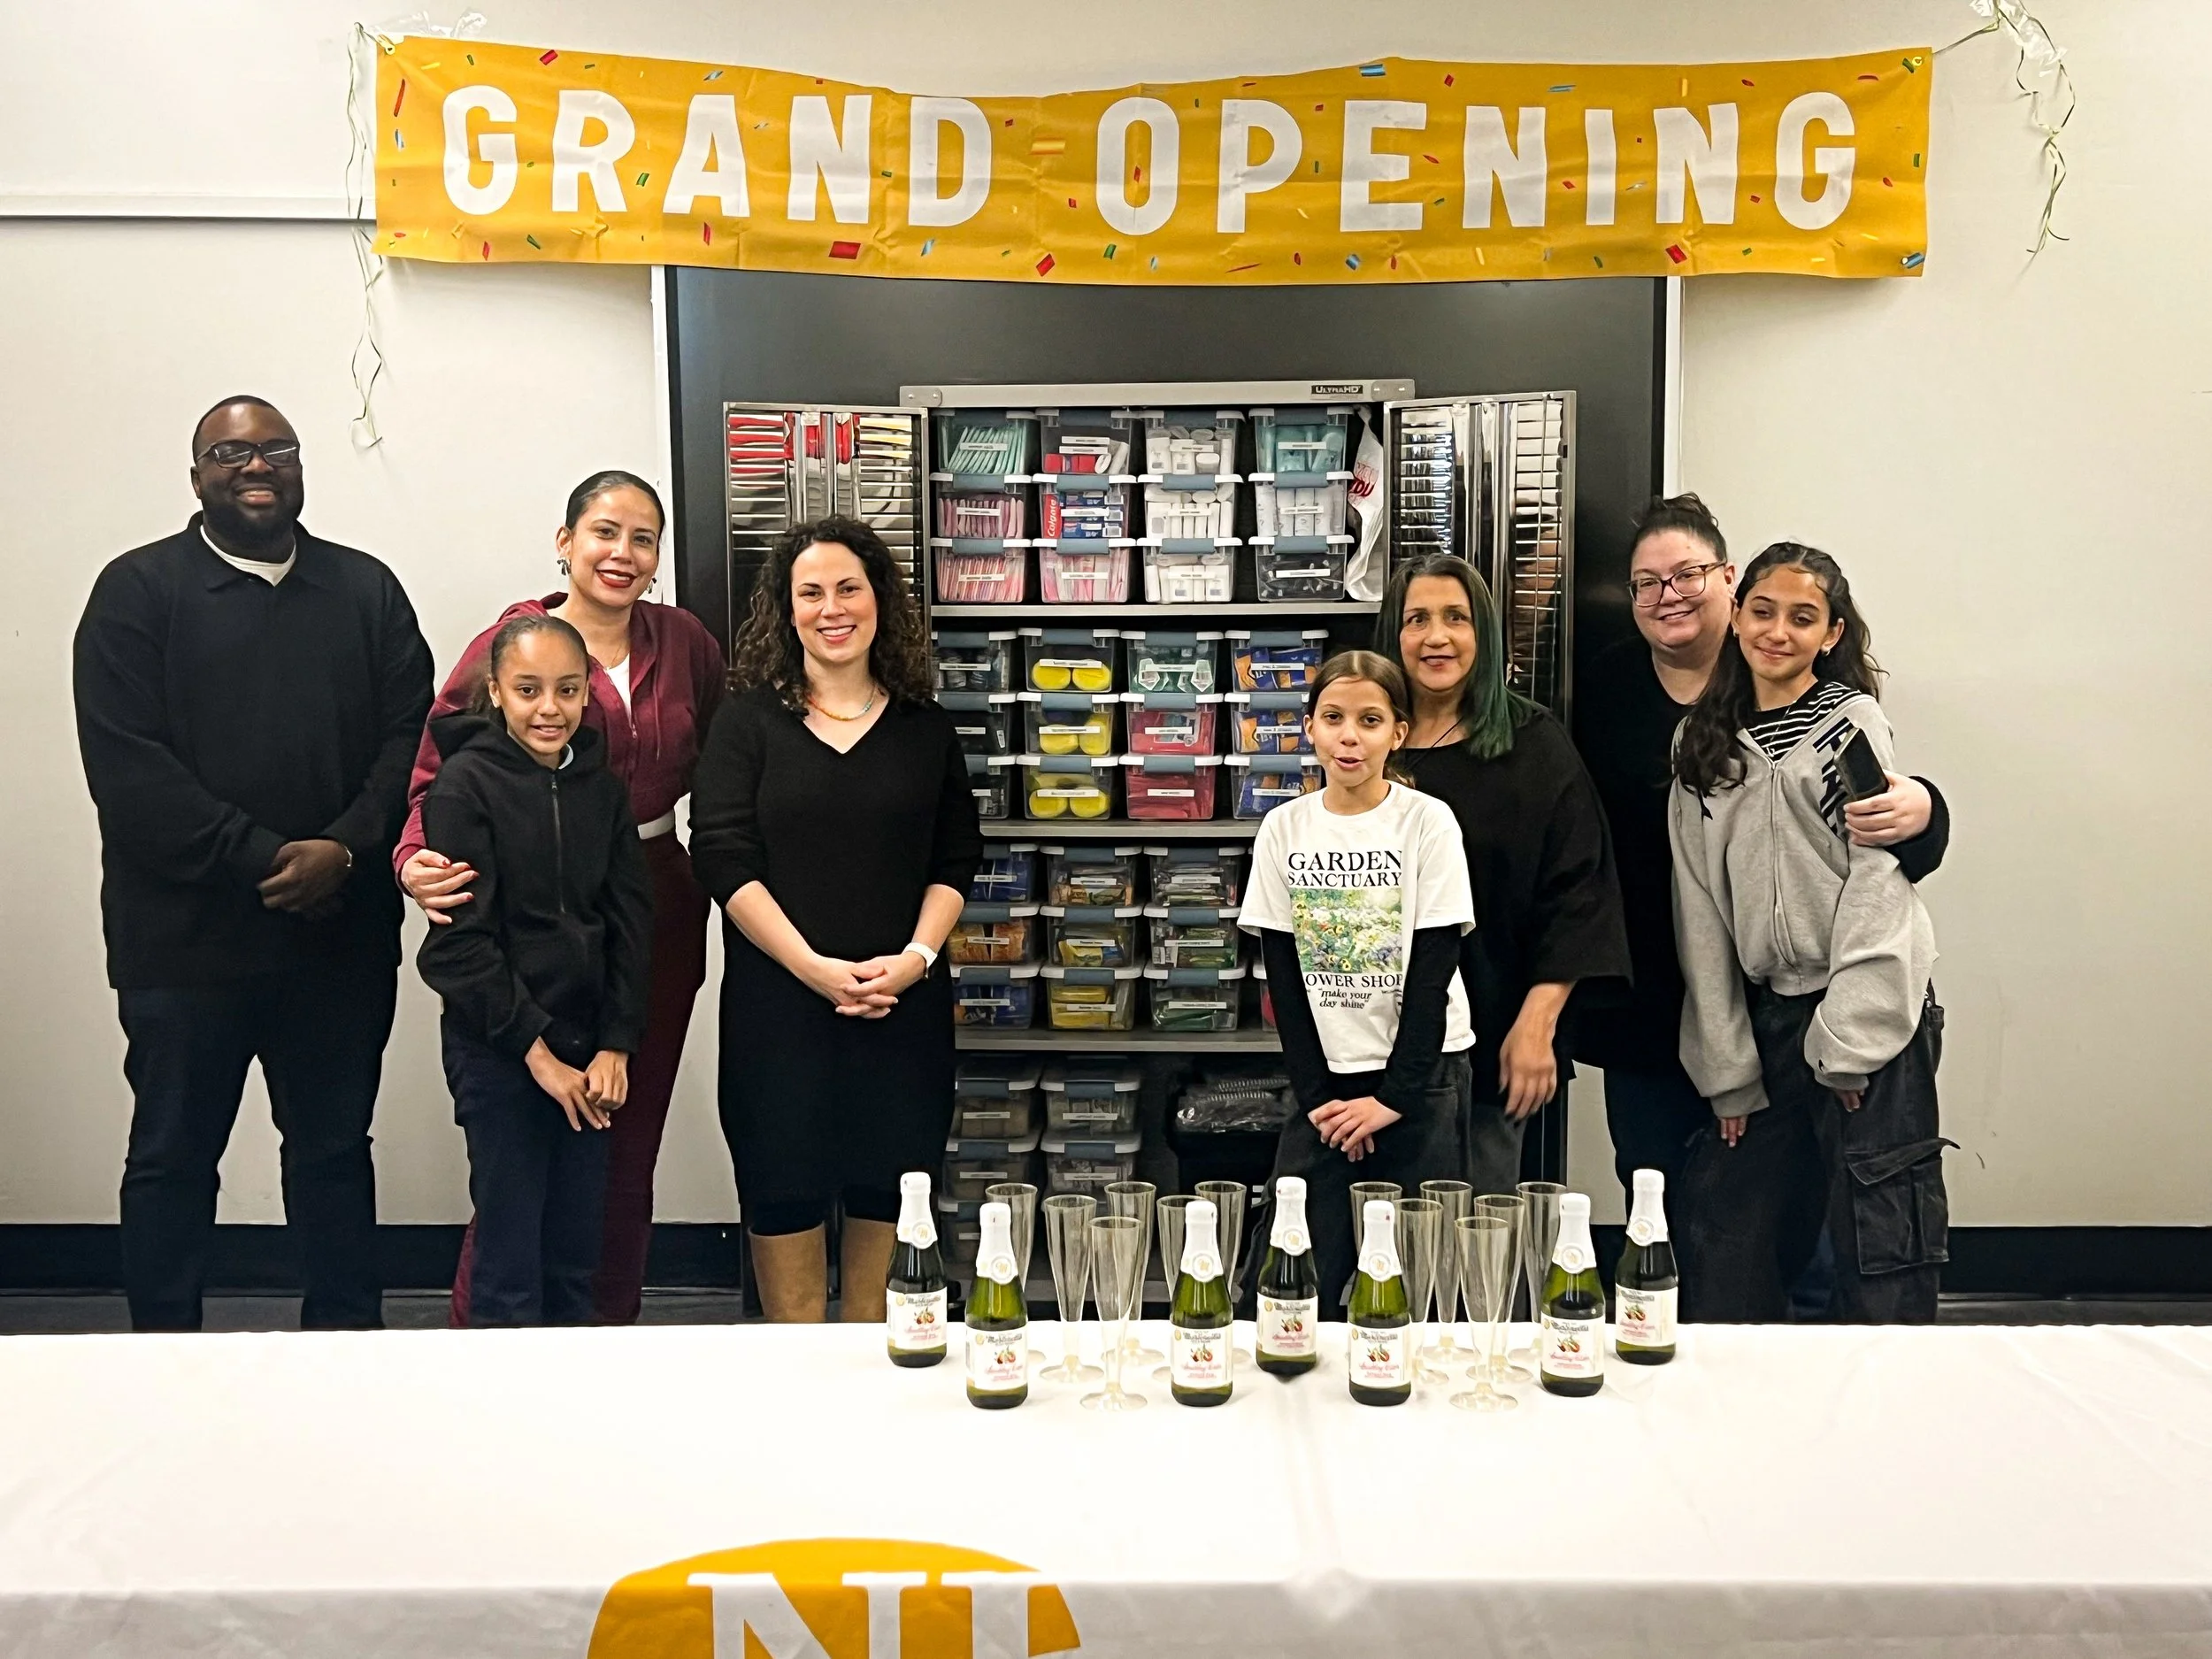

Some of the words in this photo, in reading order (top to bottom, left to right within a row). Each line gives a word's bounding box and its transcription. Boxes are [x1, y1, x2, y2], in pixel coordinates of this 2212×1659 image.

[442, 85, 992, 227] GRAND
[1094, 91, 1856, 236] OPENING
[1047, 498, 1058, 537] Colgate
[1288, 850, 1402, 872] GARDEN
[1287, 872, 1402, 887] SANCTUARY
[1305, 973, 1356, 987] OWER
[1319, 998, 1338, 1008] day
[1349, 991, 1372, 1000] your
